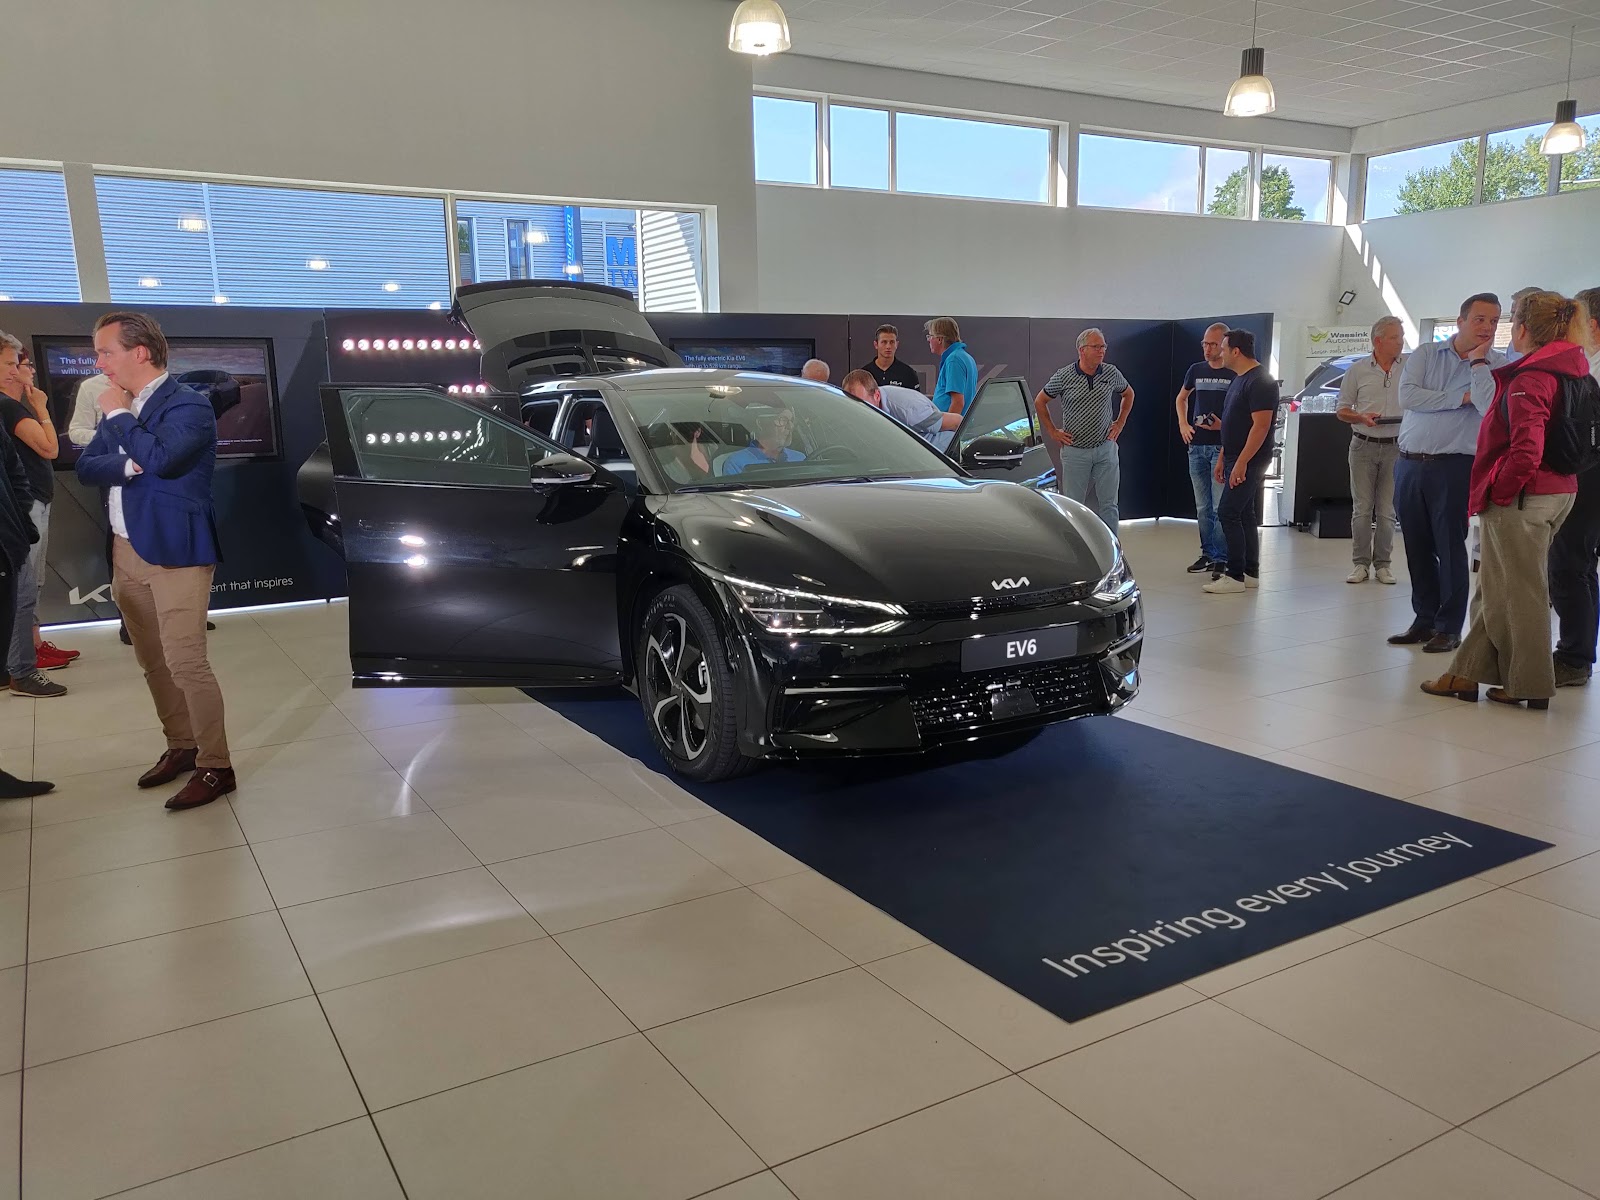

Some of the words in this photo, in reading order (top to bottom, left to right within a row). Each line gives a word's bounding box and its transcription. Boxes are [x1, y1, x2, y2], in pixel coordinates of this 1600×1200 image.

[60, 357, 77, 365] The
[77, 357, 97, 365] fully
[229, 580, 251, 591] that
[253, 576, 294, 590] inspires
[991, 576, 1031, 591] KIA
[1006, 638, 1037, 659] EV6
[1042, 906, 1247, 978] Inspiring
[1235, 871, 1349, 913] every
[1328, 830, 1473, 883] journey
